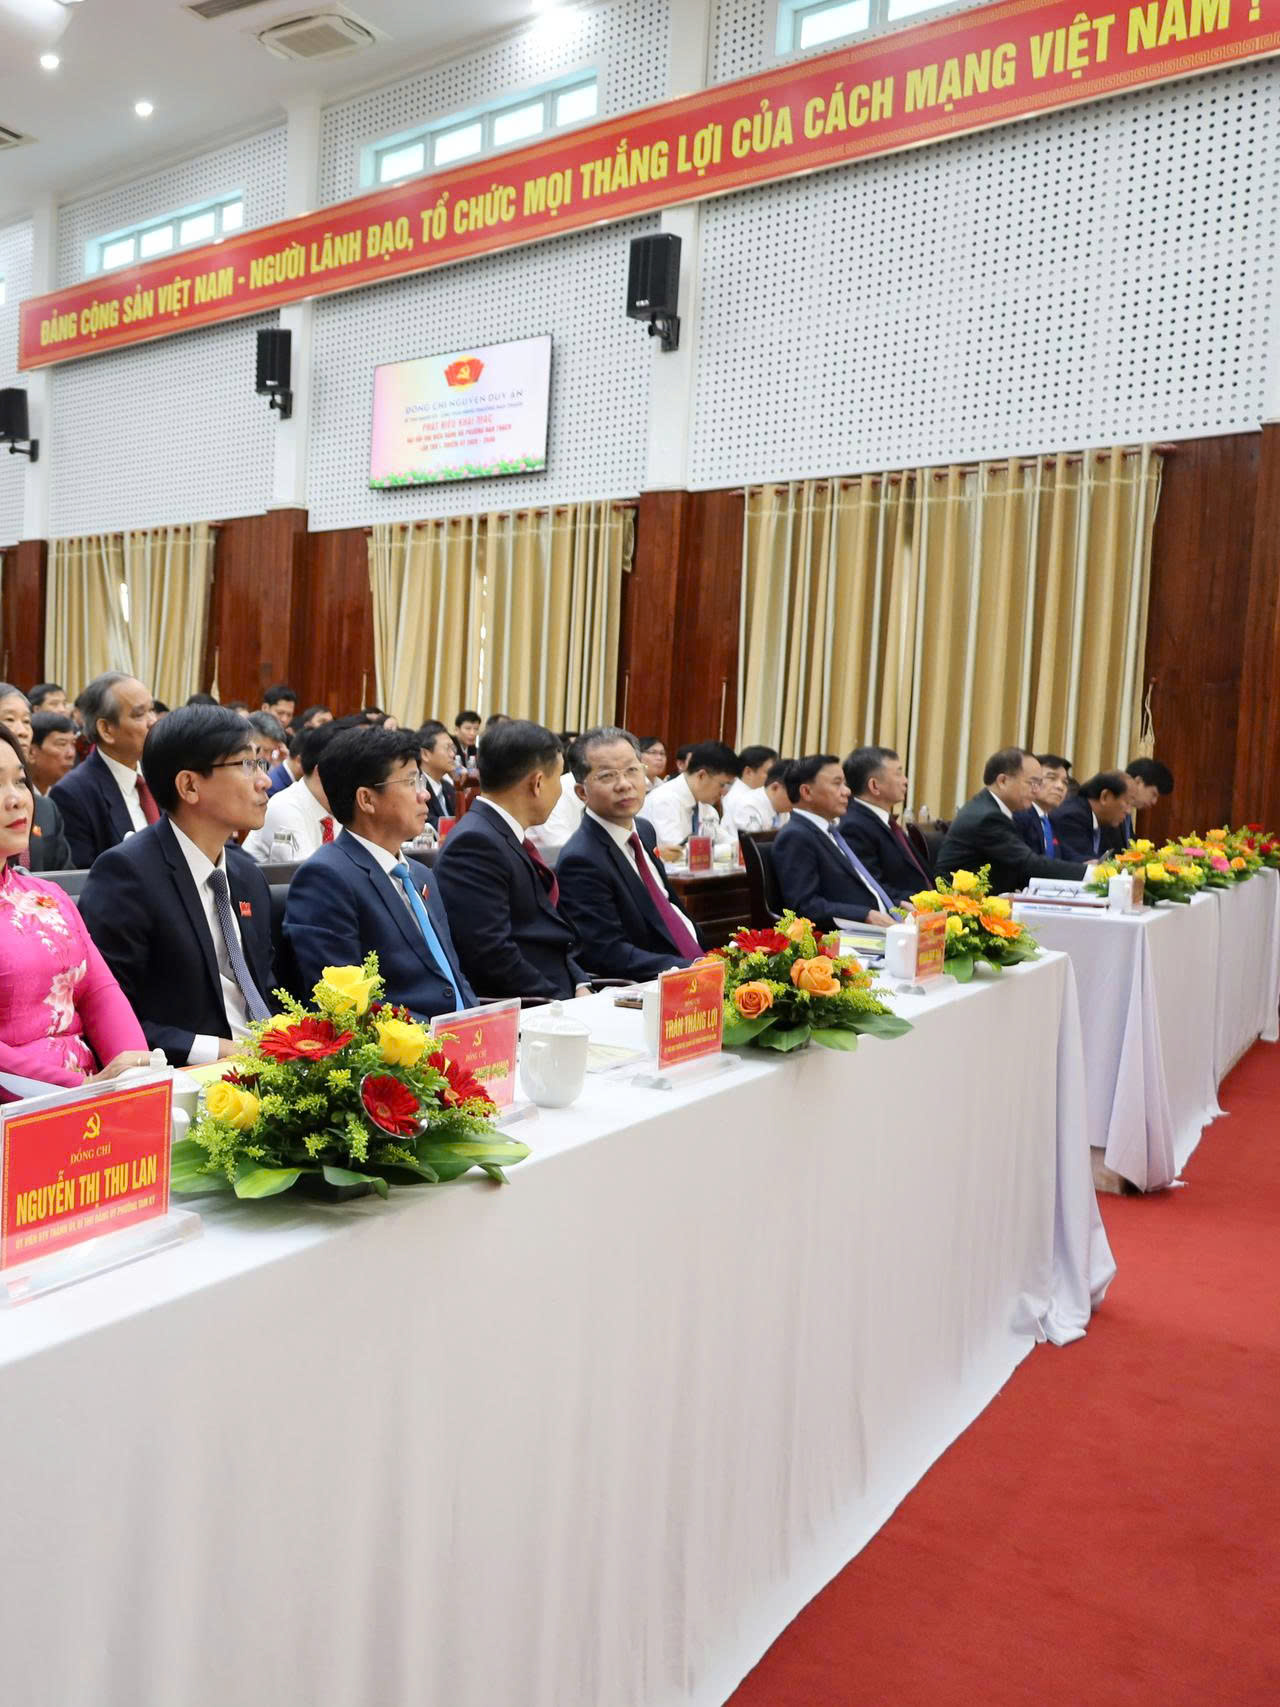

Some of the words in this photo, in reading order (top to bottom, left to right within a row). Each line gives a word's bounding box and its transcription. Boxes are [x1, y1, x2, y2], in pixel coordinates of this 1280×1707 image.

[40, 308, 77, 346] ĐẢNG
[80, 300, 119, 338] CỘNG
[123, 284, 154, 324] SẢN
[158, 275, 191, 317] VIỆT
[194, 267, 234, 304] NAM
[249, 241, 306, 290] NGƯỜI
[310, 232, 362, 274] LÃNH
[367, 216, 414, 261] ĐẠO,
[420, 191, 450, 243] TỔ
[453, 183, 517, 234] CHỨC
[523, 168, 573, 217] MỌI
[580, 138, 670, 200] THẮNG
[677, 122, 723, 176] LỢI
[731, 98, 793, 159] CỦA
[803, 74, 894, 139] CÁCH
[904, 42, 1017, 112] MẠNG
[1030, 12, 1116, 79] VIỆT
[1126, 0, 1231, 54] NAM
[16, 1170, 75, 1228] NGUYỄN
[79, 1171, 100, 1209] THỊ
[104, 1162, 129, 1199] THU
[132, 1154, 157, 1190] LAN
